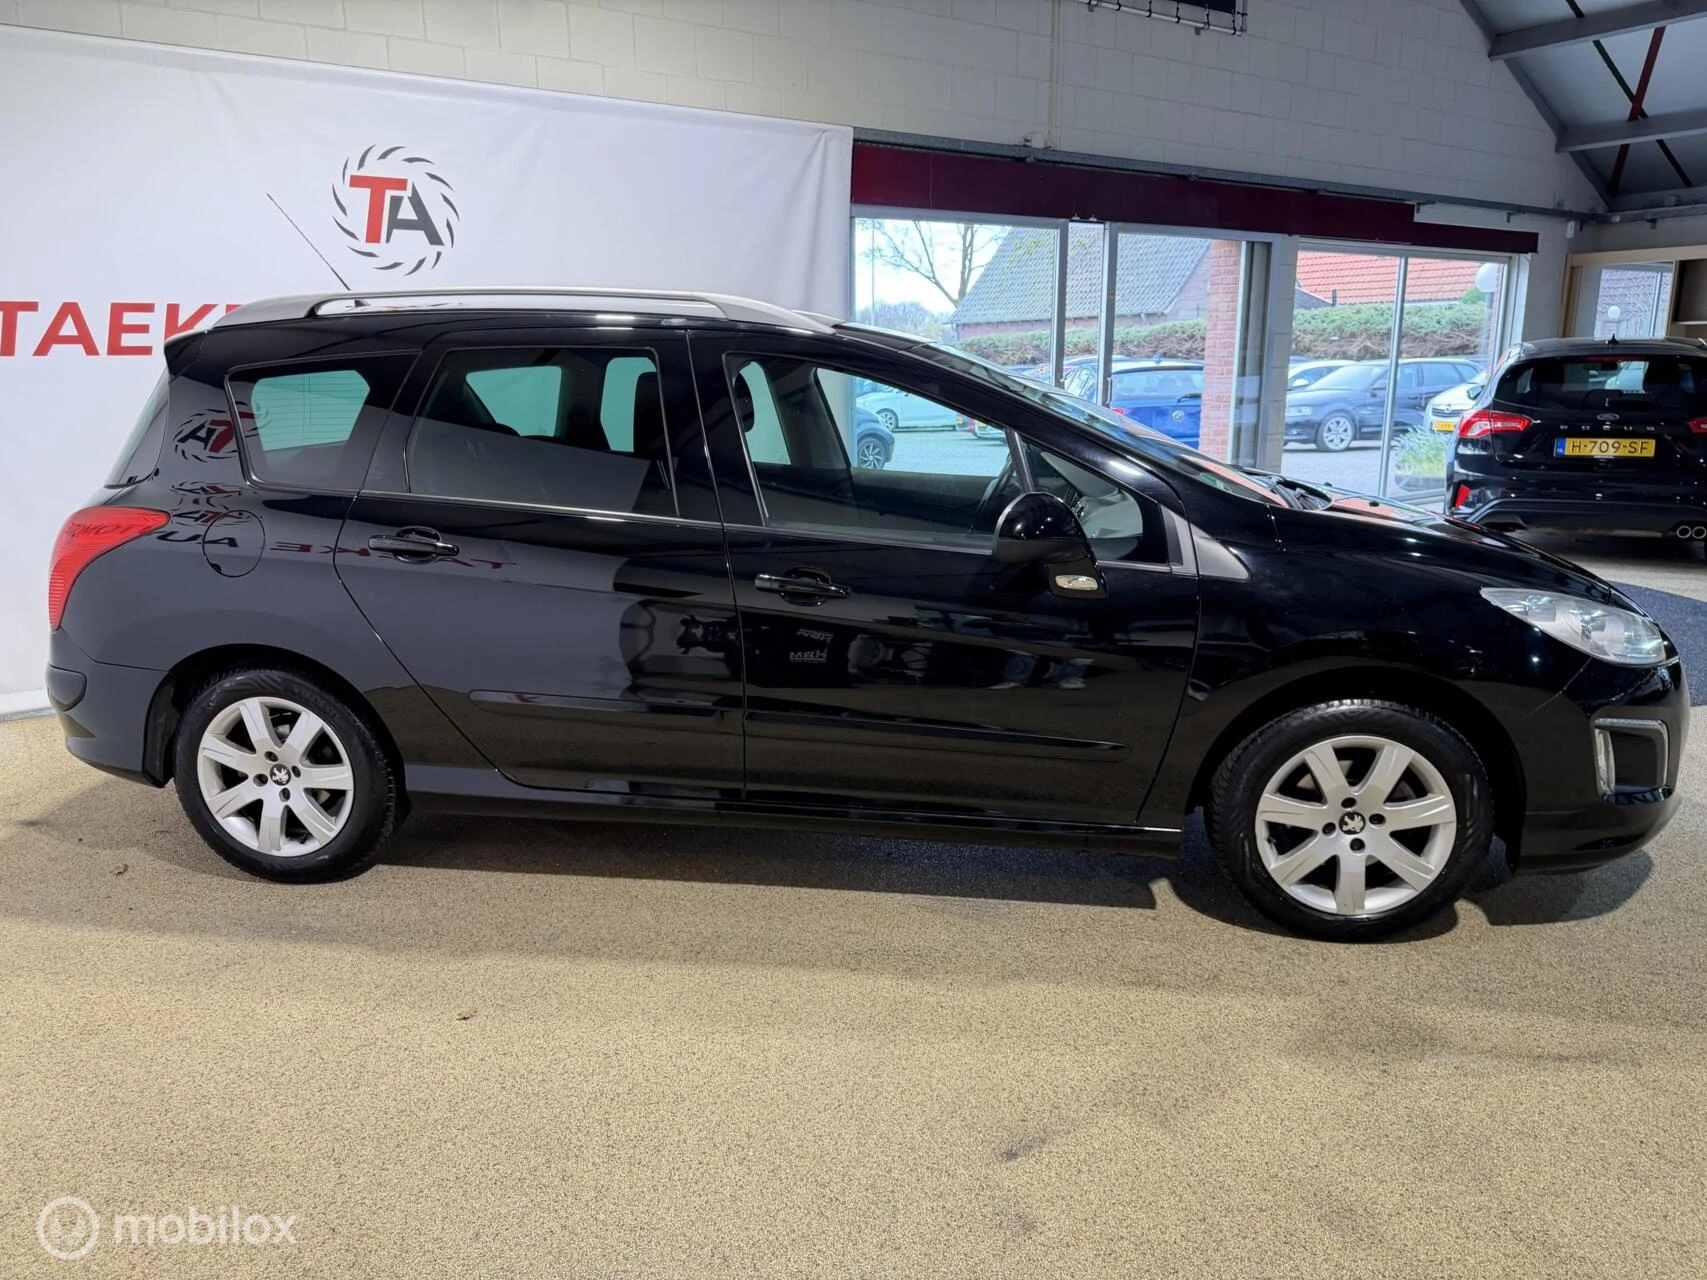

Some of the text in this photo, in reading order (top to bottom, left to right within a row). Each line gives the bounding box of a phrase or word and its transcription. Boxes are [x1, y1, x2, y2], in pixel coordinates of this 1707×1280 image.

[349, 175, 445, 246] TA
[0, 301, 243, 357] TAEK
[1571, 441, 1649, 454] H-709-SF
